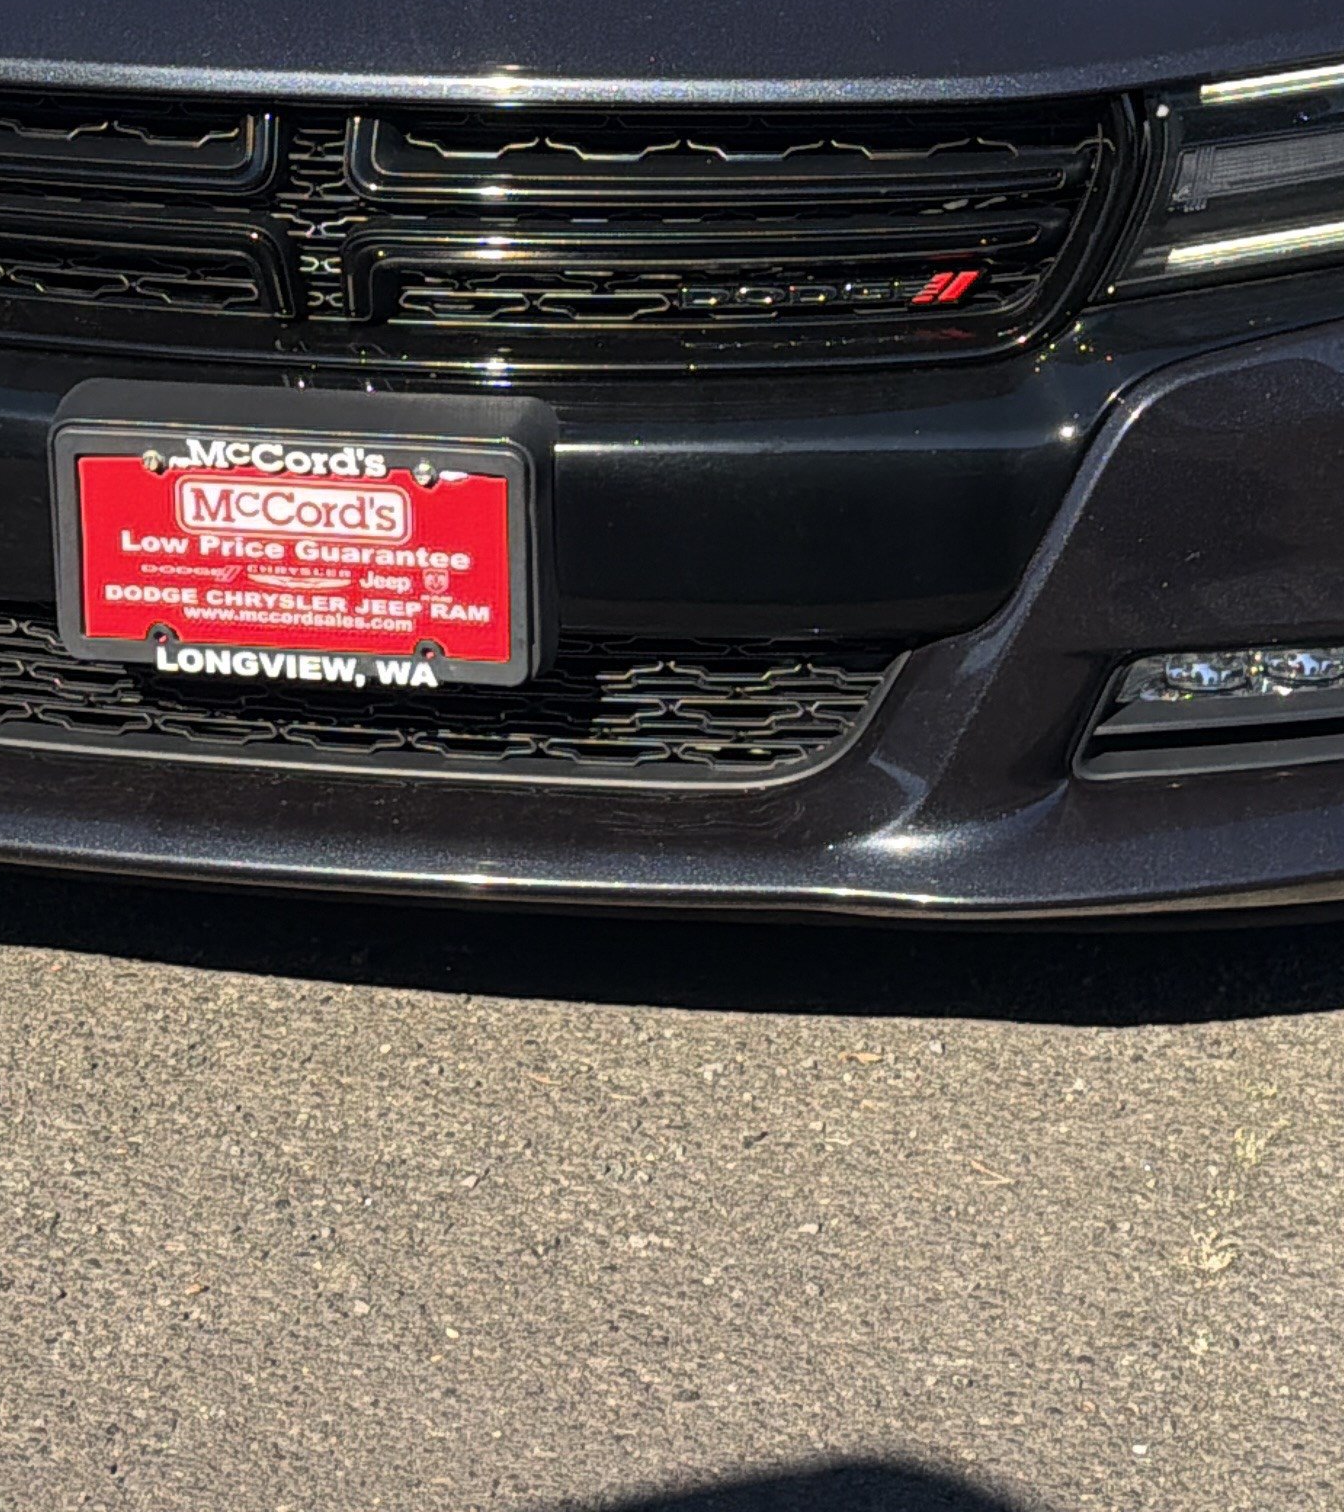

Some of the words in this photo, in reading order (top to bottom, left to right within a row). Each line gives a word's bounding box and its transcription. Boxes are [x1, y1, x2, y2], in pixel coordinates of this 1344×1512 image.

[186, 439, 387, 478] McCord's
[189, 488, 397, 532] McCord's
[121, 529, 189, 555] Low
[199, 534, 285, 560] Price
[294, 539, 472, 570] Guarantee
[359, 570, 413, 594] Jeep
[105, 585, 198, 604] DODGE
[206, 590, 348, 613] CHRYSLER
[355, 598, 422, 618] JEEP
[430, 603, 491, 623] RAM
[183, 607, 413, 632] www.mccordsales.com
[157, 646, 366, 688] LONGVIEW,
[375, 659, 439, 688] WA
